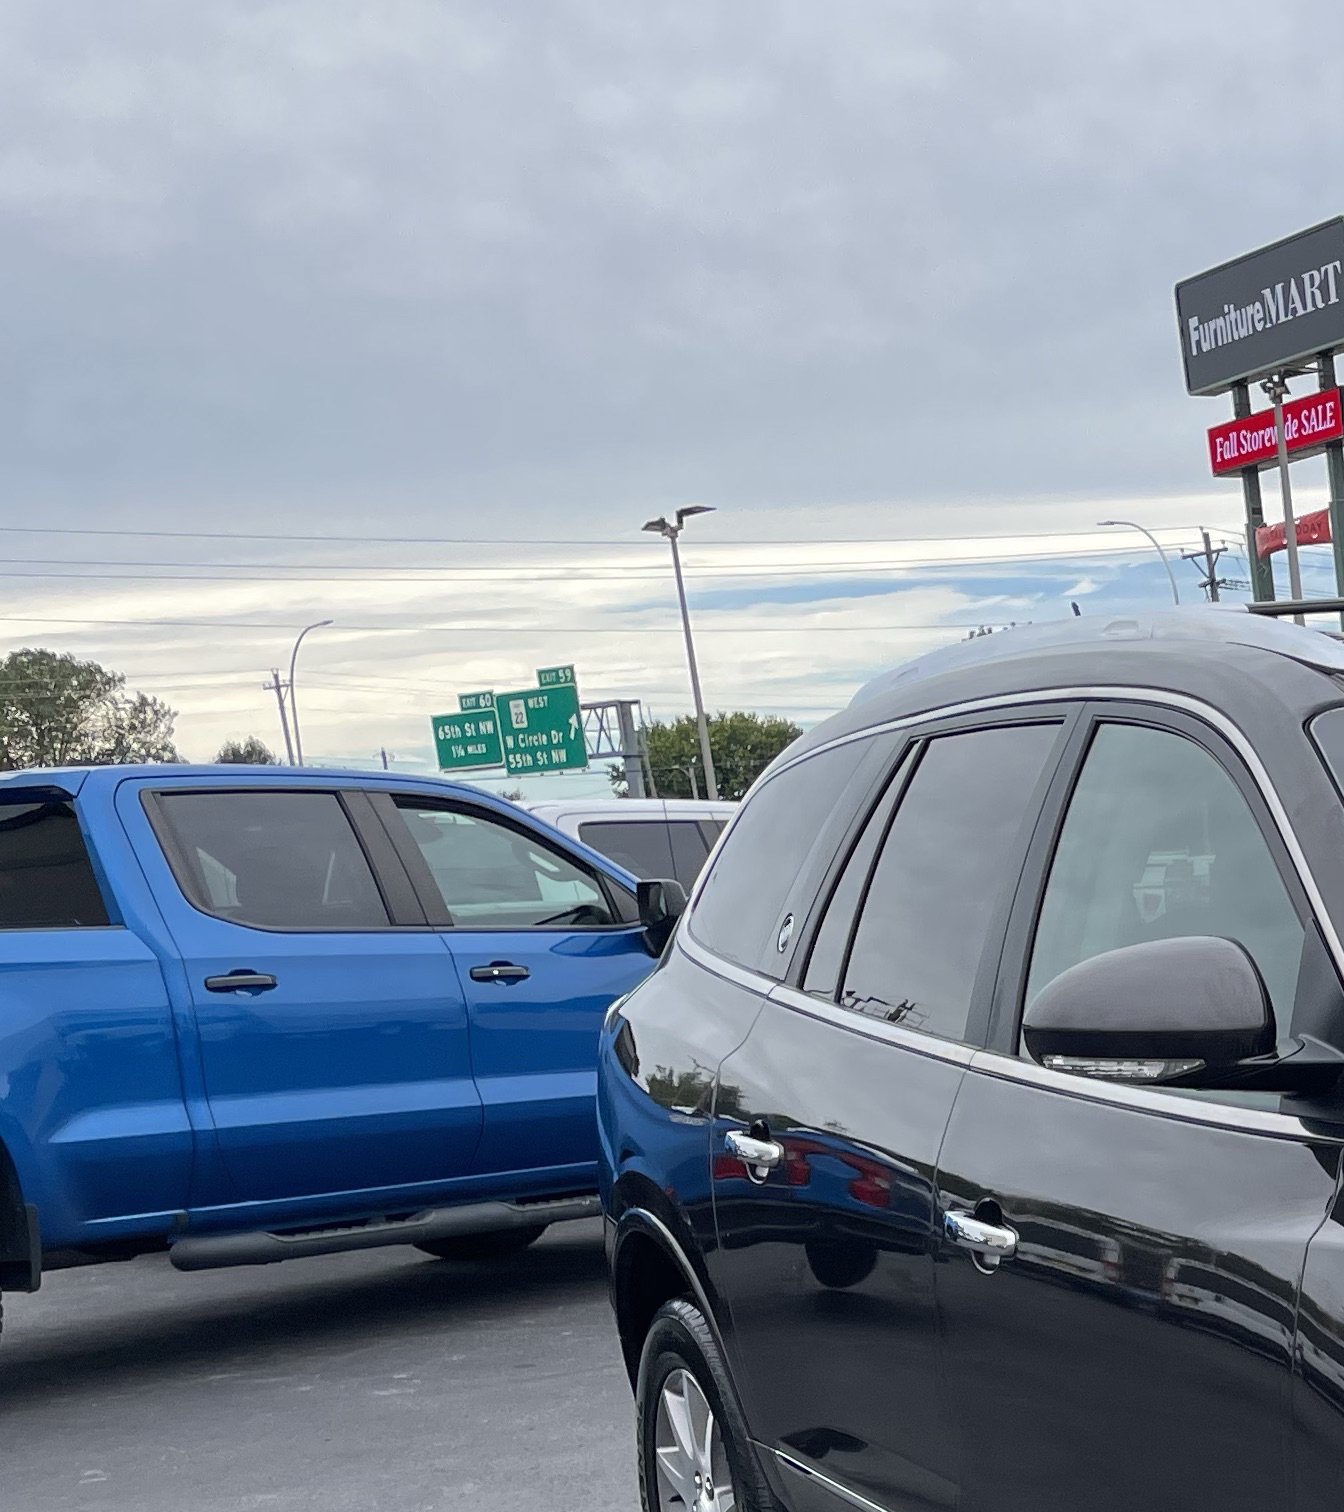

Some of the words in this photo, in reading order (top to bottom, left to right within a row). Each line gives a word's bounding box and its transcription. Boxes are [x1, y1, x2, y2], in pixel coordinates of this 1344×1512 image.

[1216, 431, 1239, 462] Fall
[1301, 402, 1335, 436] SALE
[541, 672, 557, 684] EXIT
[558, 669, 572, 683] 59
[479, 694, 492, 708] 60
[527, 696, 548, 709] WEST
[514, 711, 524, 725] 22
[438, 724, 462, 740] 65th
[465, 722, 476, 737] St
[479, 720, 494, 735] NW
[505, 735, 514, 749] W
[518, 732, 548, 748] Circle
[550, 729, 563, 745] Dr
[508, 753, 533, 769] 55th
[536, 751, 548, 766] St
[551, 748, 567, 764] NW
